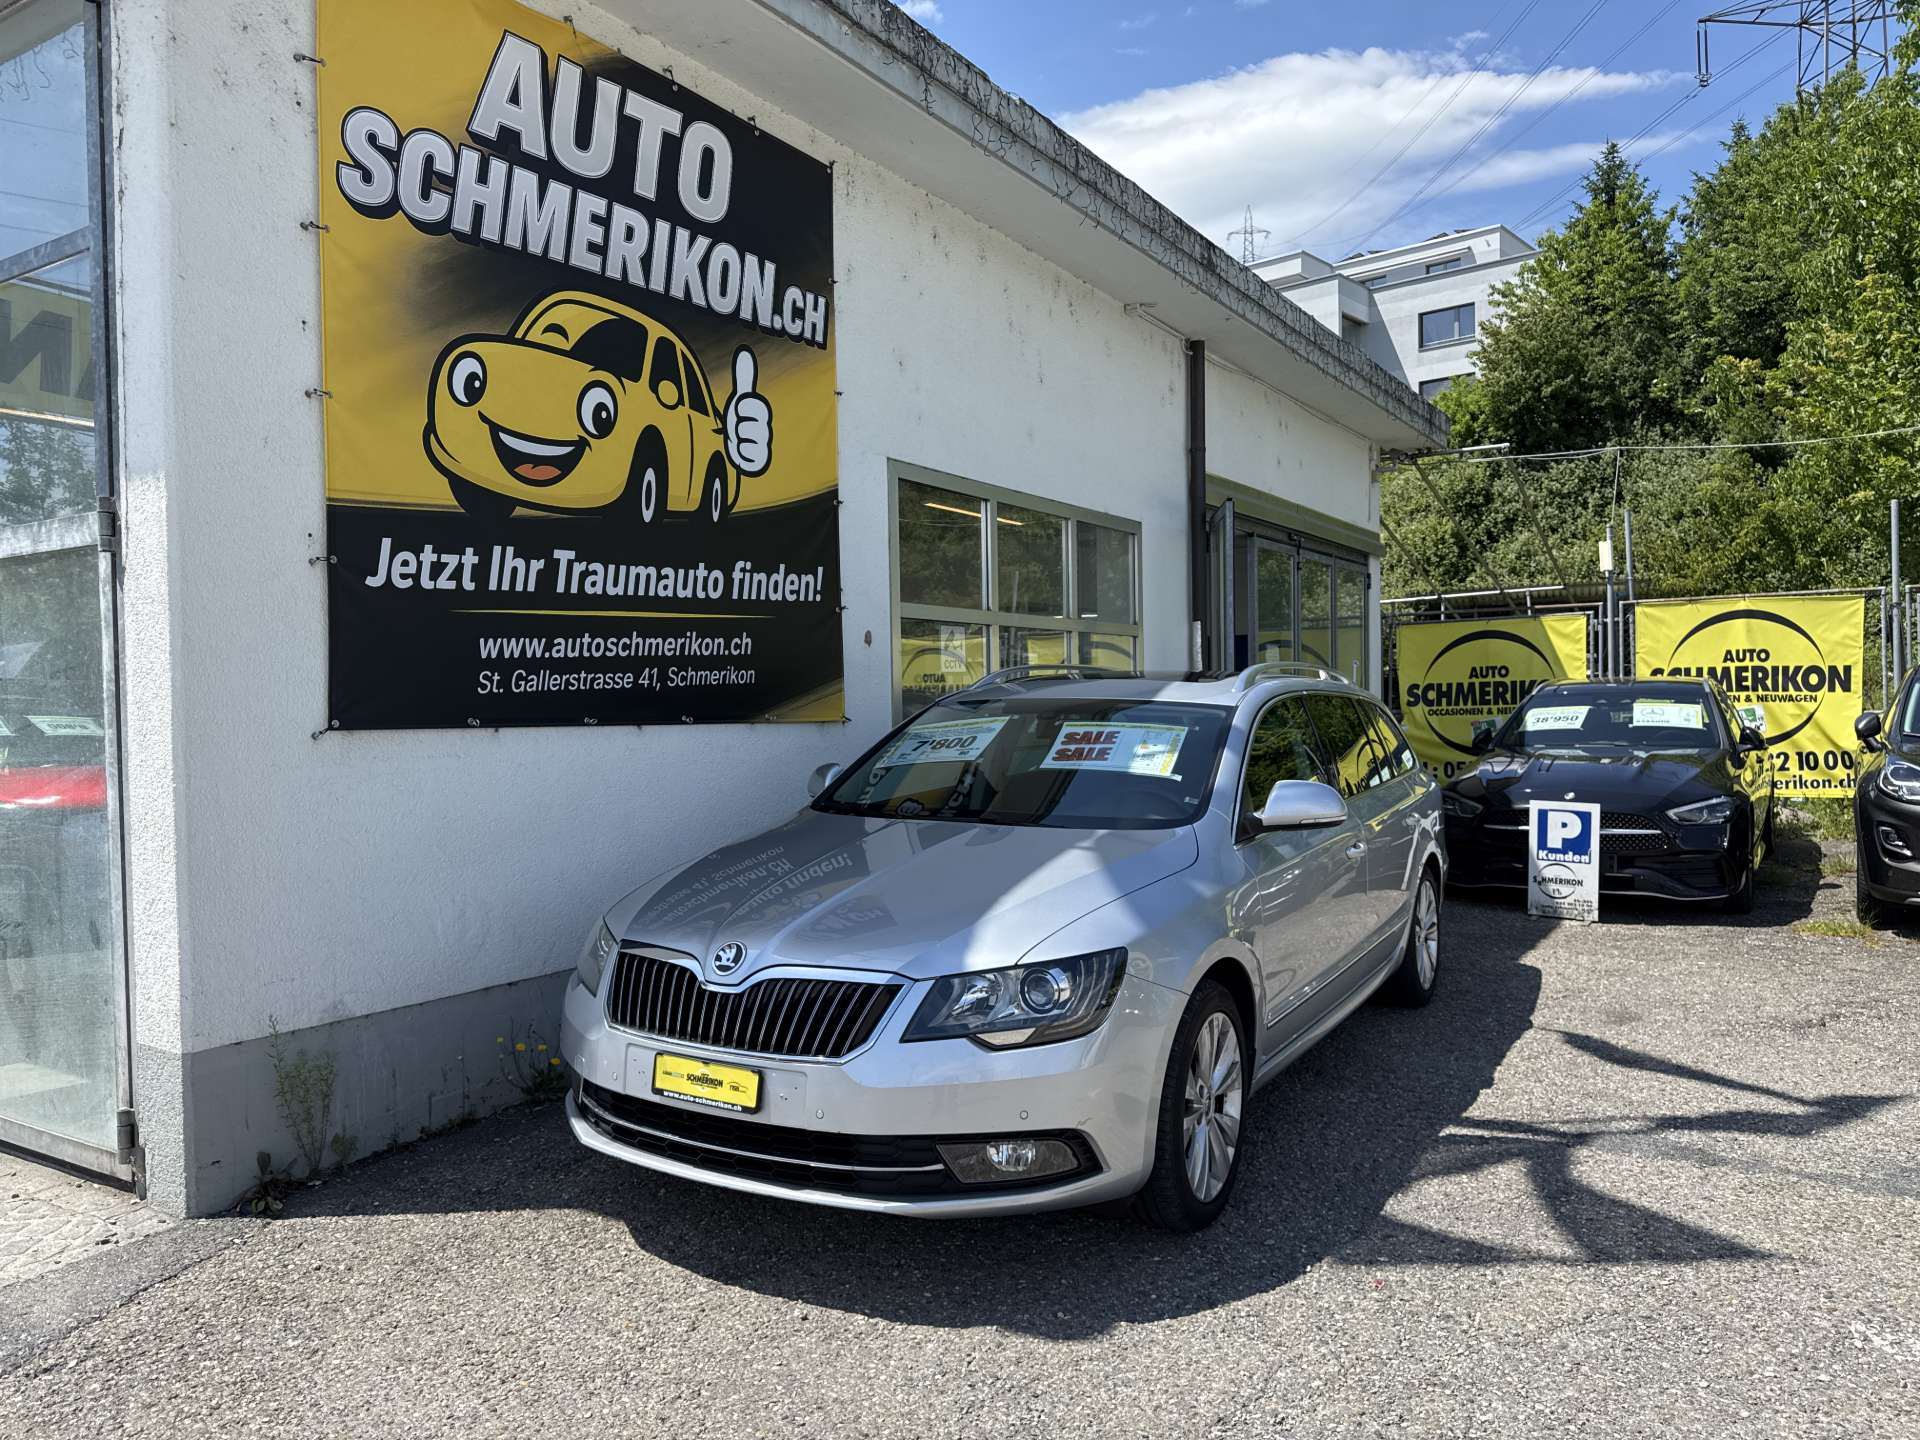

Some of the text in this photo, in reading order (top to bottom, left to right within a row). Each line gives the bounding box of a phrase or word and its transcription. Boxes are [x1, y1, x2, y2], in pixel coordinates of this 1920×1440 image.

[467, 28, 734, 225] AUTO
[336, 105, 829, 349] SCHMERIKON.CH
[365, 537, 824, 602] Jetzt Ihr Traumauto finden!
[479, 632, 752, 660] www.autoschmerikon.ch
[1722, 648, 1771, 663] AUTO
[477, 666, 756, 694] St. Gallerstrasse 41, Schmerikon
[1469, 665, 1510, 680] AUTO
[1406, 679, 1549, 708] SCHMERIK
[1744, 694, 1753, 703] &
[1756, 693, 1818, 703] NEUWAGEN
[1427, 706, 1484, 717] OCCASIONEN
[1486, 706, 1493, 715] &
[912, 735, 977, 752] 7'800
[1060, 730, 1121, 746] SALE
[1051, 746, 1113, 762] SALE
[1547, 811, 1582, 849] P
[1538, 849, 1590, 864] Kunden
